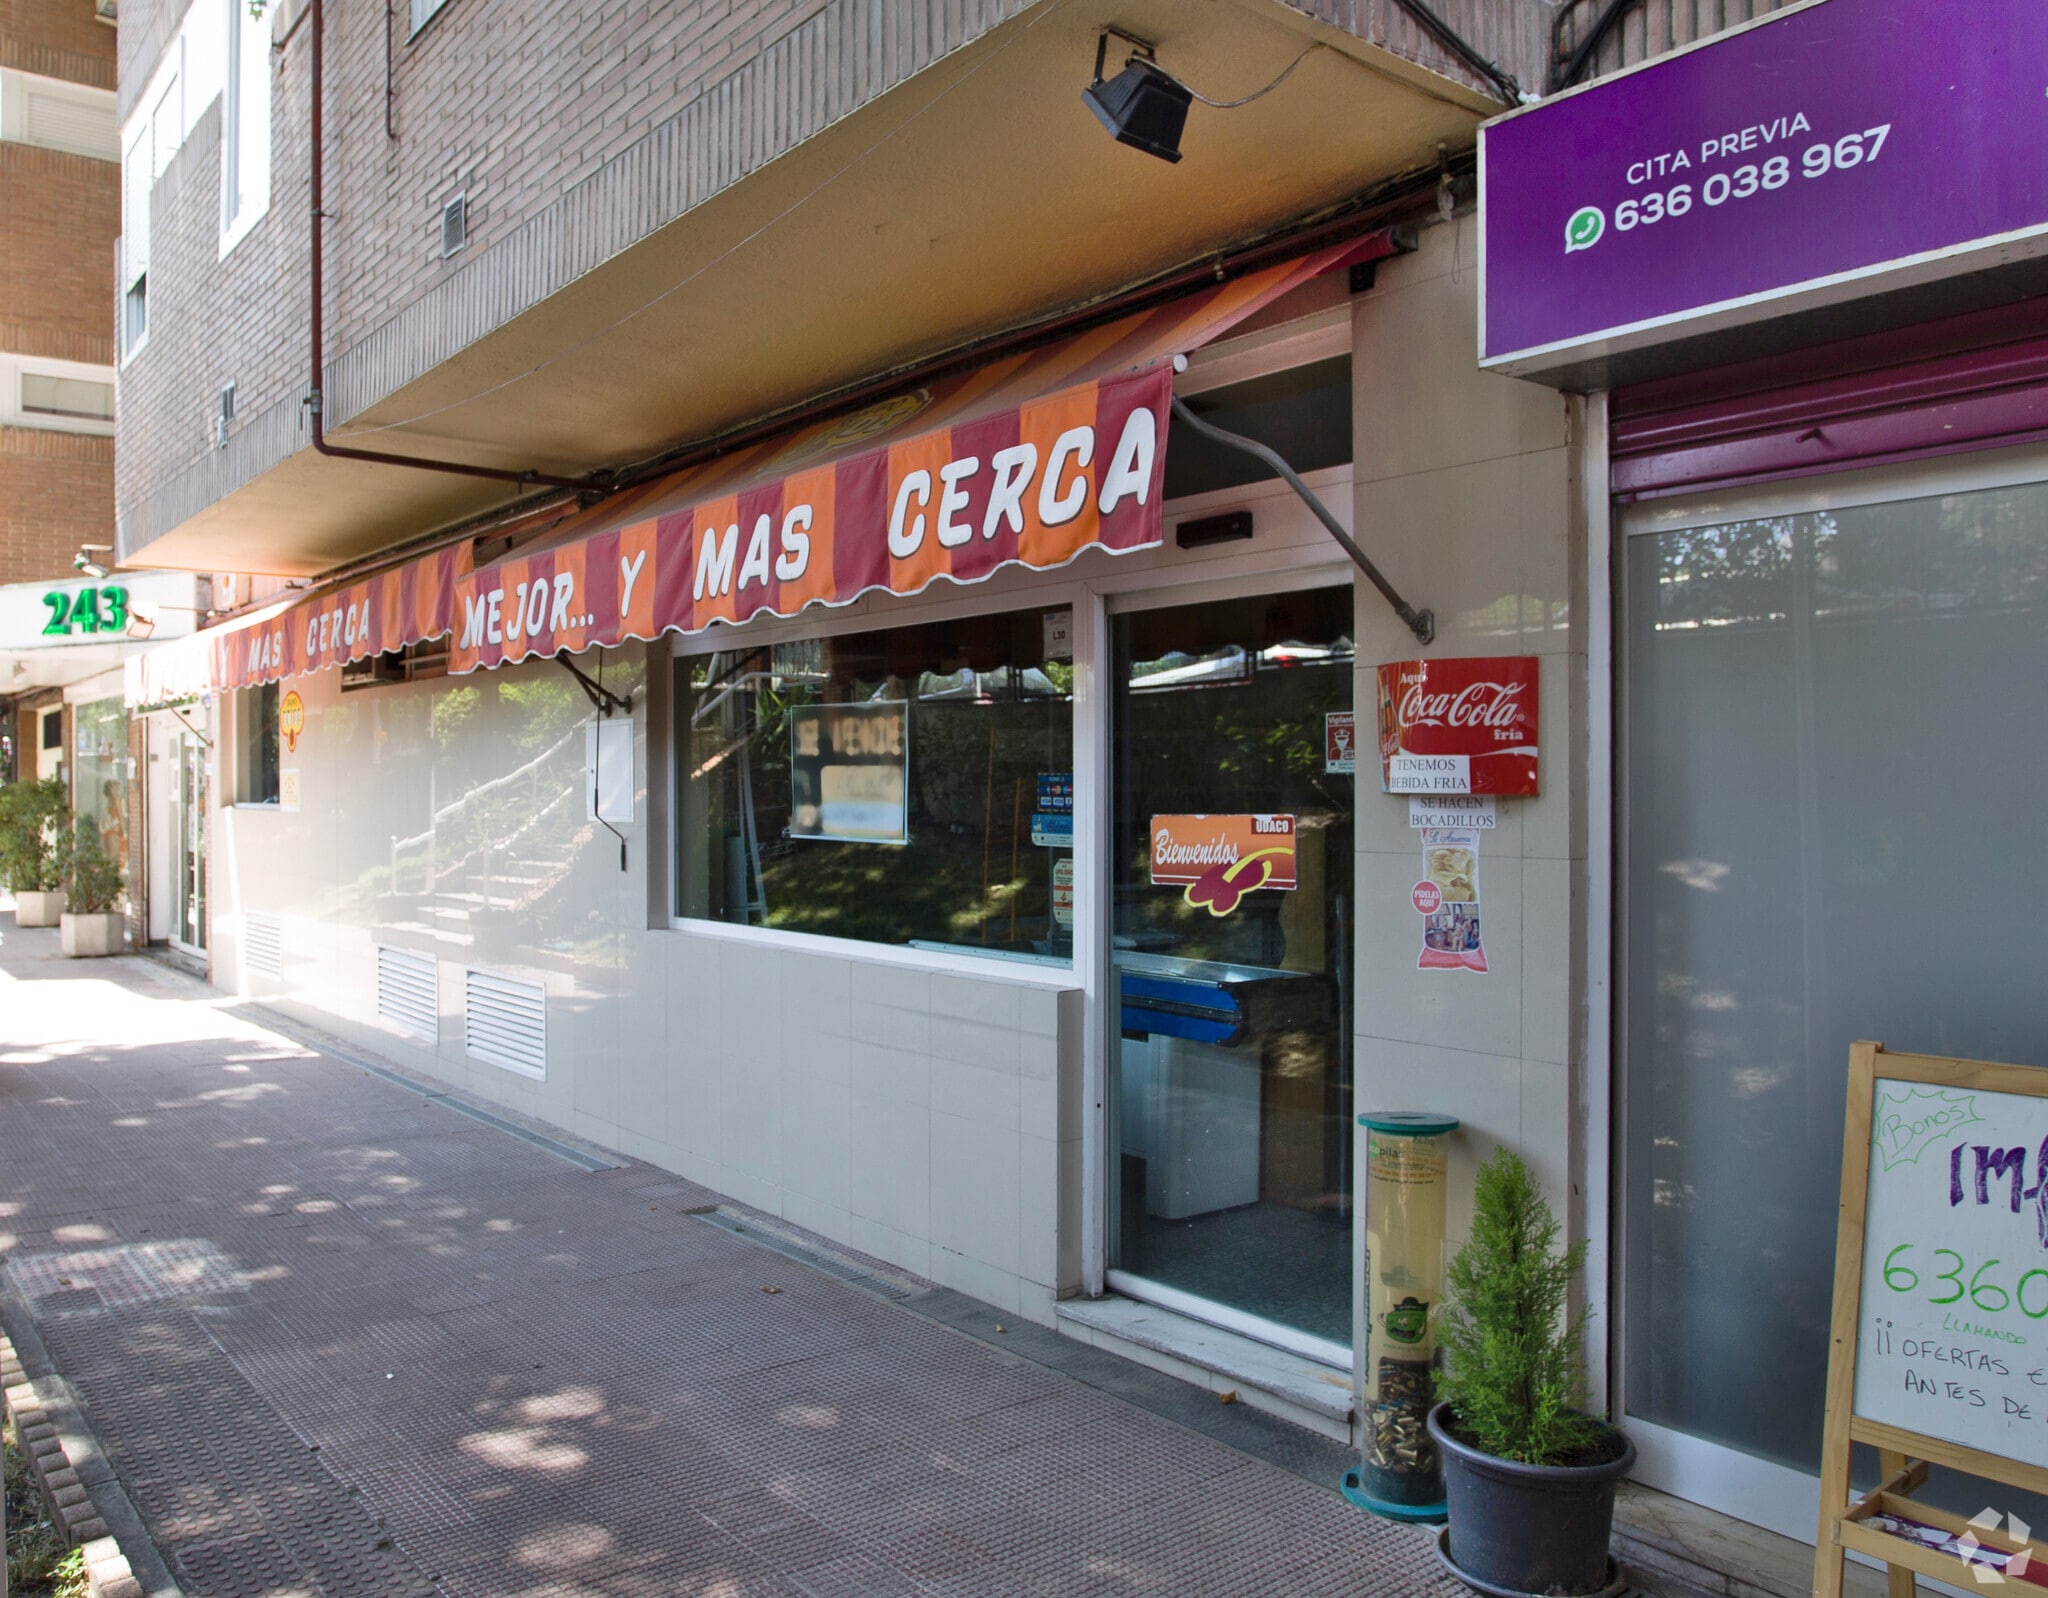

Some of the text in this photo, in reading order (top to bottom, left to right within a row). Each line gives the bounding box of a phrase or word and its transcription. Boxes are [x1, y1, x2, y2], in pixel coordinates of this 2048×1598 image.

[1626, 111, 1811, 185] CITA PREVIA
[1614, 123, 1892, 232] 636 038 967
[620, 550, 646, 618] Y
[693, 504, 813, 601] MAS
[887, 407, 1157, 559] CERCA
[42, 586, 129, 636] 243
[247, 631, 282, 673] MAS
[306, 598, 370, 658] CERCA
[1391, 777, 1468, 789] BEBIDA FRIA
[1397, 759, 1456, 771] TENEMOS
[1412, 815, 1494, 827] BOCADILLOS
[1420, 797, 1484, 809] SE HACEN
[1155, 828, 1239, 865] Bienvenidos
[1882, 1106, 1966, 1159] Bonos
[1905, 1369, 2032, 1420] ANTES DE
